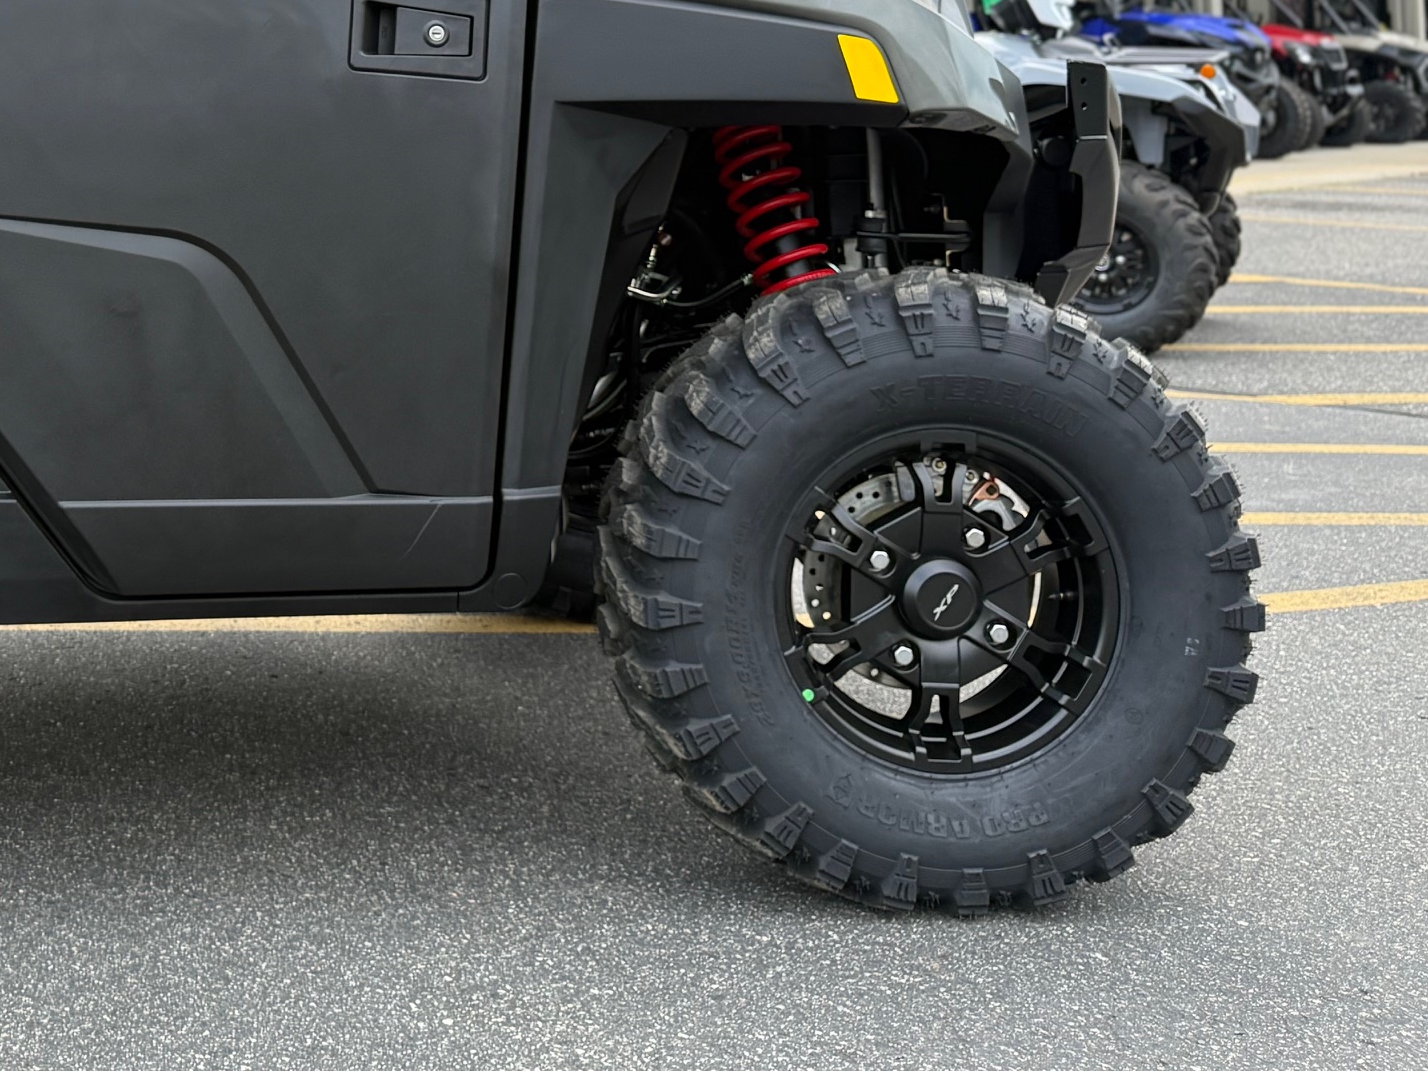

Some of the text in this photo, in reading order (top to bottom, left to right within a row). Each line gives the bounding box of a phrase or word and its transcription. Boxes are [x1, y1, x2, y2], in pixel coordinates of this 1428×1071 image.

[869, 373, 1090, 438] X-TERRAIN
[932, 583, 960, 622] XP
[856, 797, 1051, 840] PRO ARMOR
